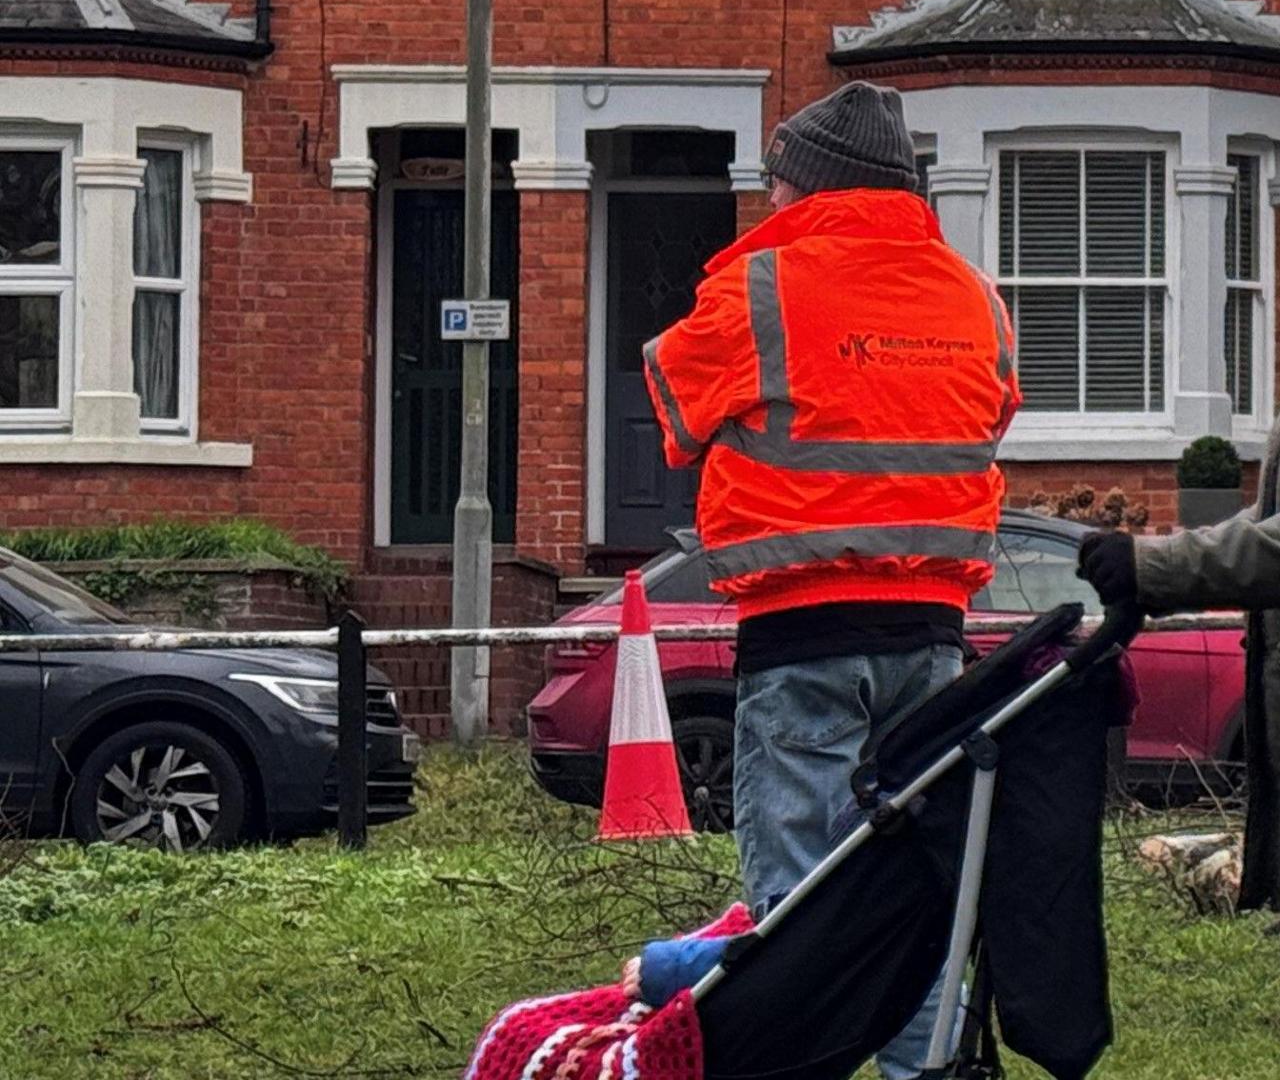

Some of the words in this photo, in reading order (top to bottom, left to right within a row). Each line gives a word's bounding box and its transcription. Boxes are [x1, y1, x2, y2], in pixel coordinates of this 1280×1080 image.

[449, 312, 464, 329] P
[879, 336, 925, 349] Milton
[925, 337, 974, 352] Keynes
[880, 352, 906, 369] City
[908, 353, 954, 368] Council
